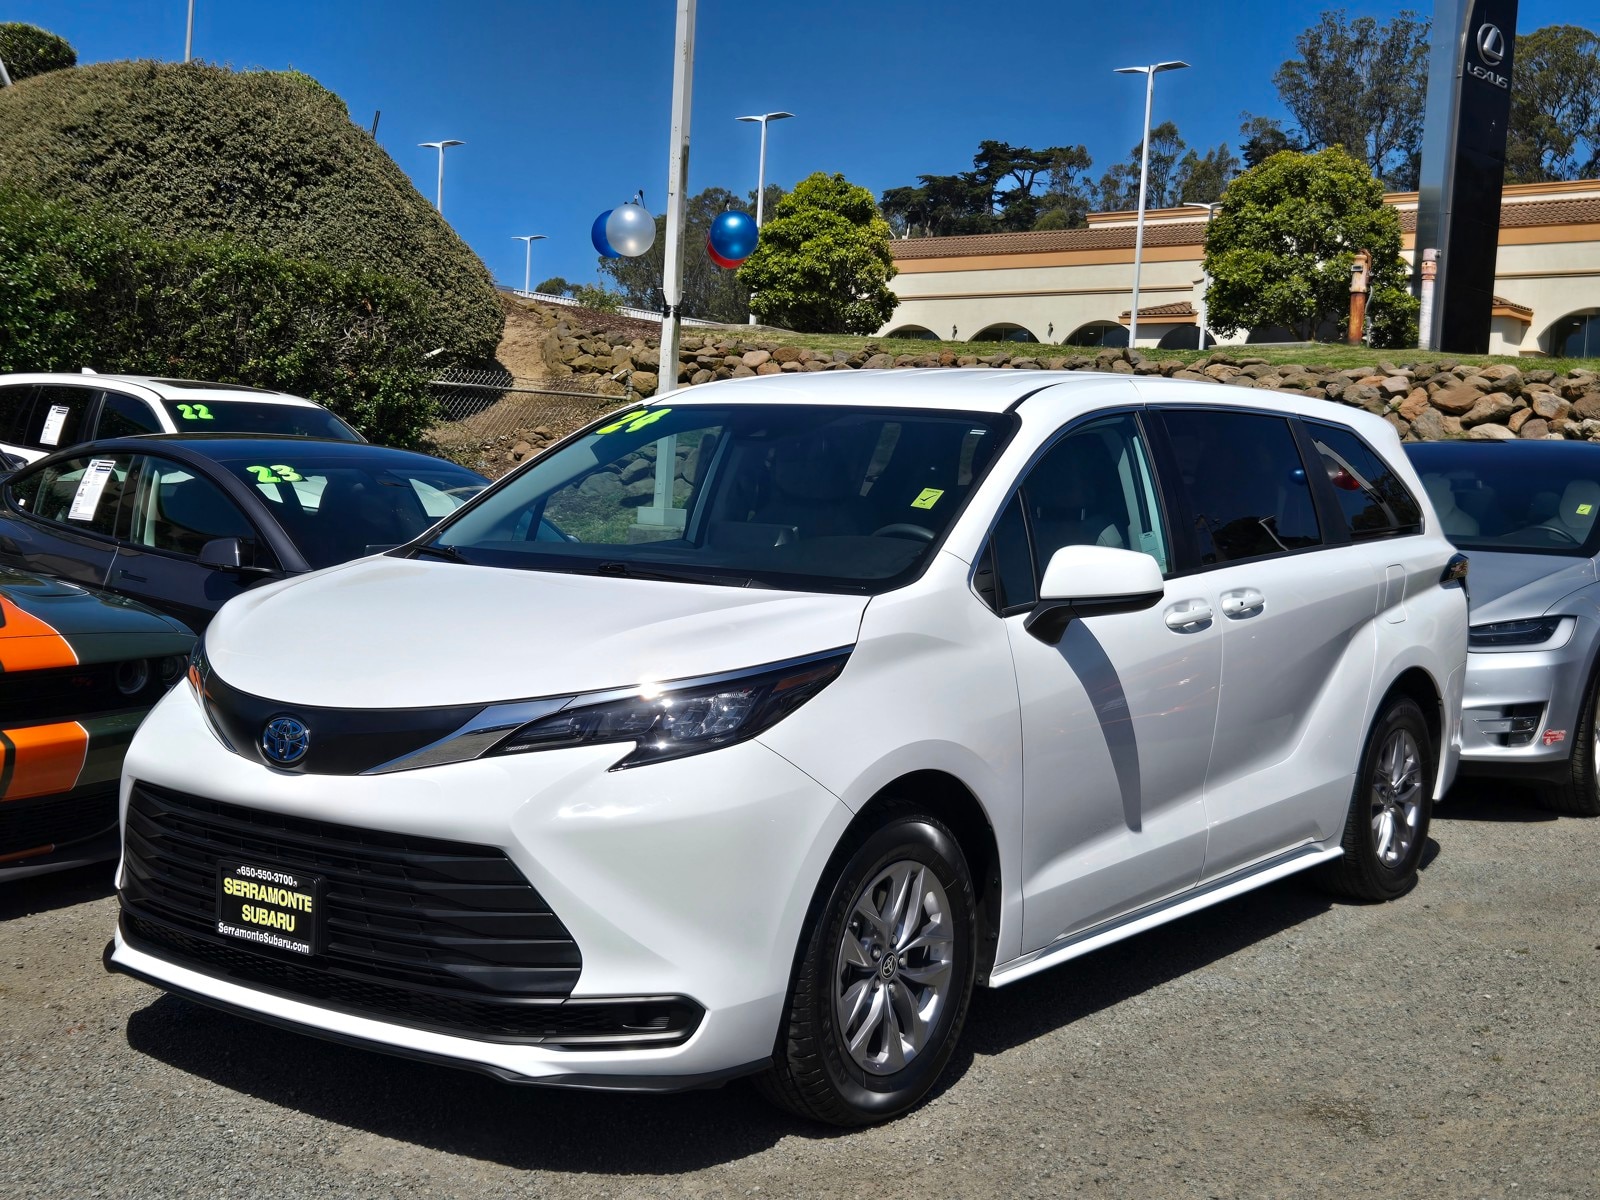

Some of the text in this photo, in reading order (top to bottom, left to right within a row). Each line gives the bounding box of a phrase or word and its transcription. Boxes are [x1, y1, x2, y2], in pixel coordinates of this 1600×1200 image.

[1467, 62, 1508, 89] LEXUS
[176, 403, 214, 420] 22
[246, 464, 303, 483] 23
[223, 877, 313, 913] SERRAMONTE
[241, 904, 296, 932] SUBARU
[218, 922, 310, 954] SerramonteSubaru.com
